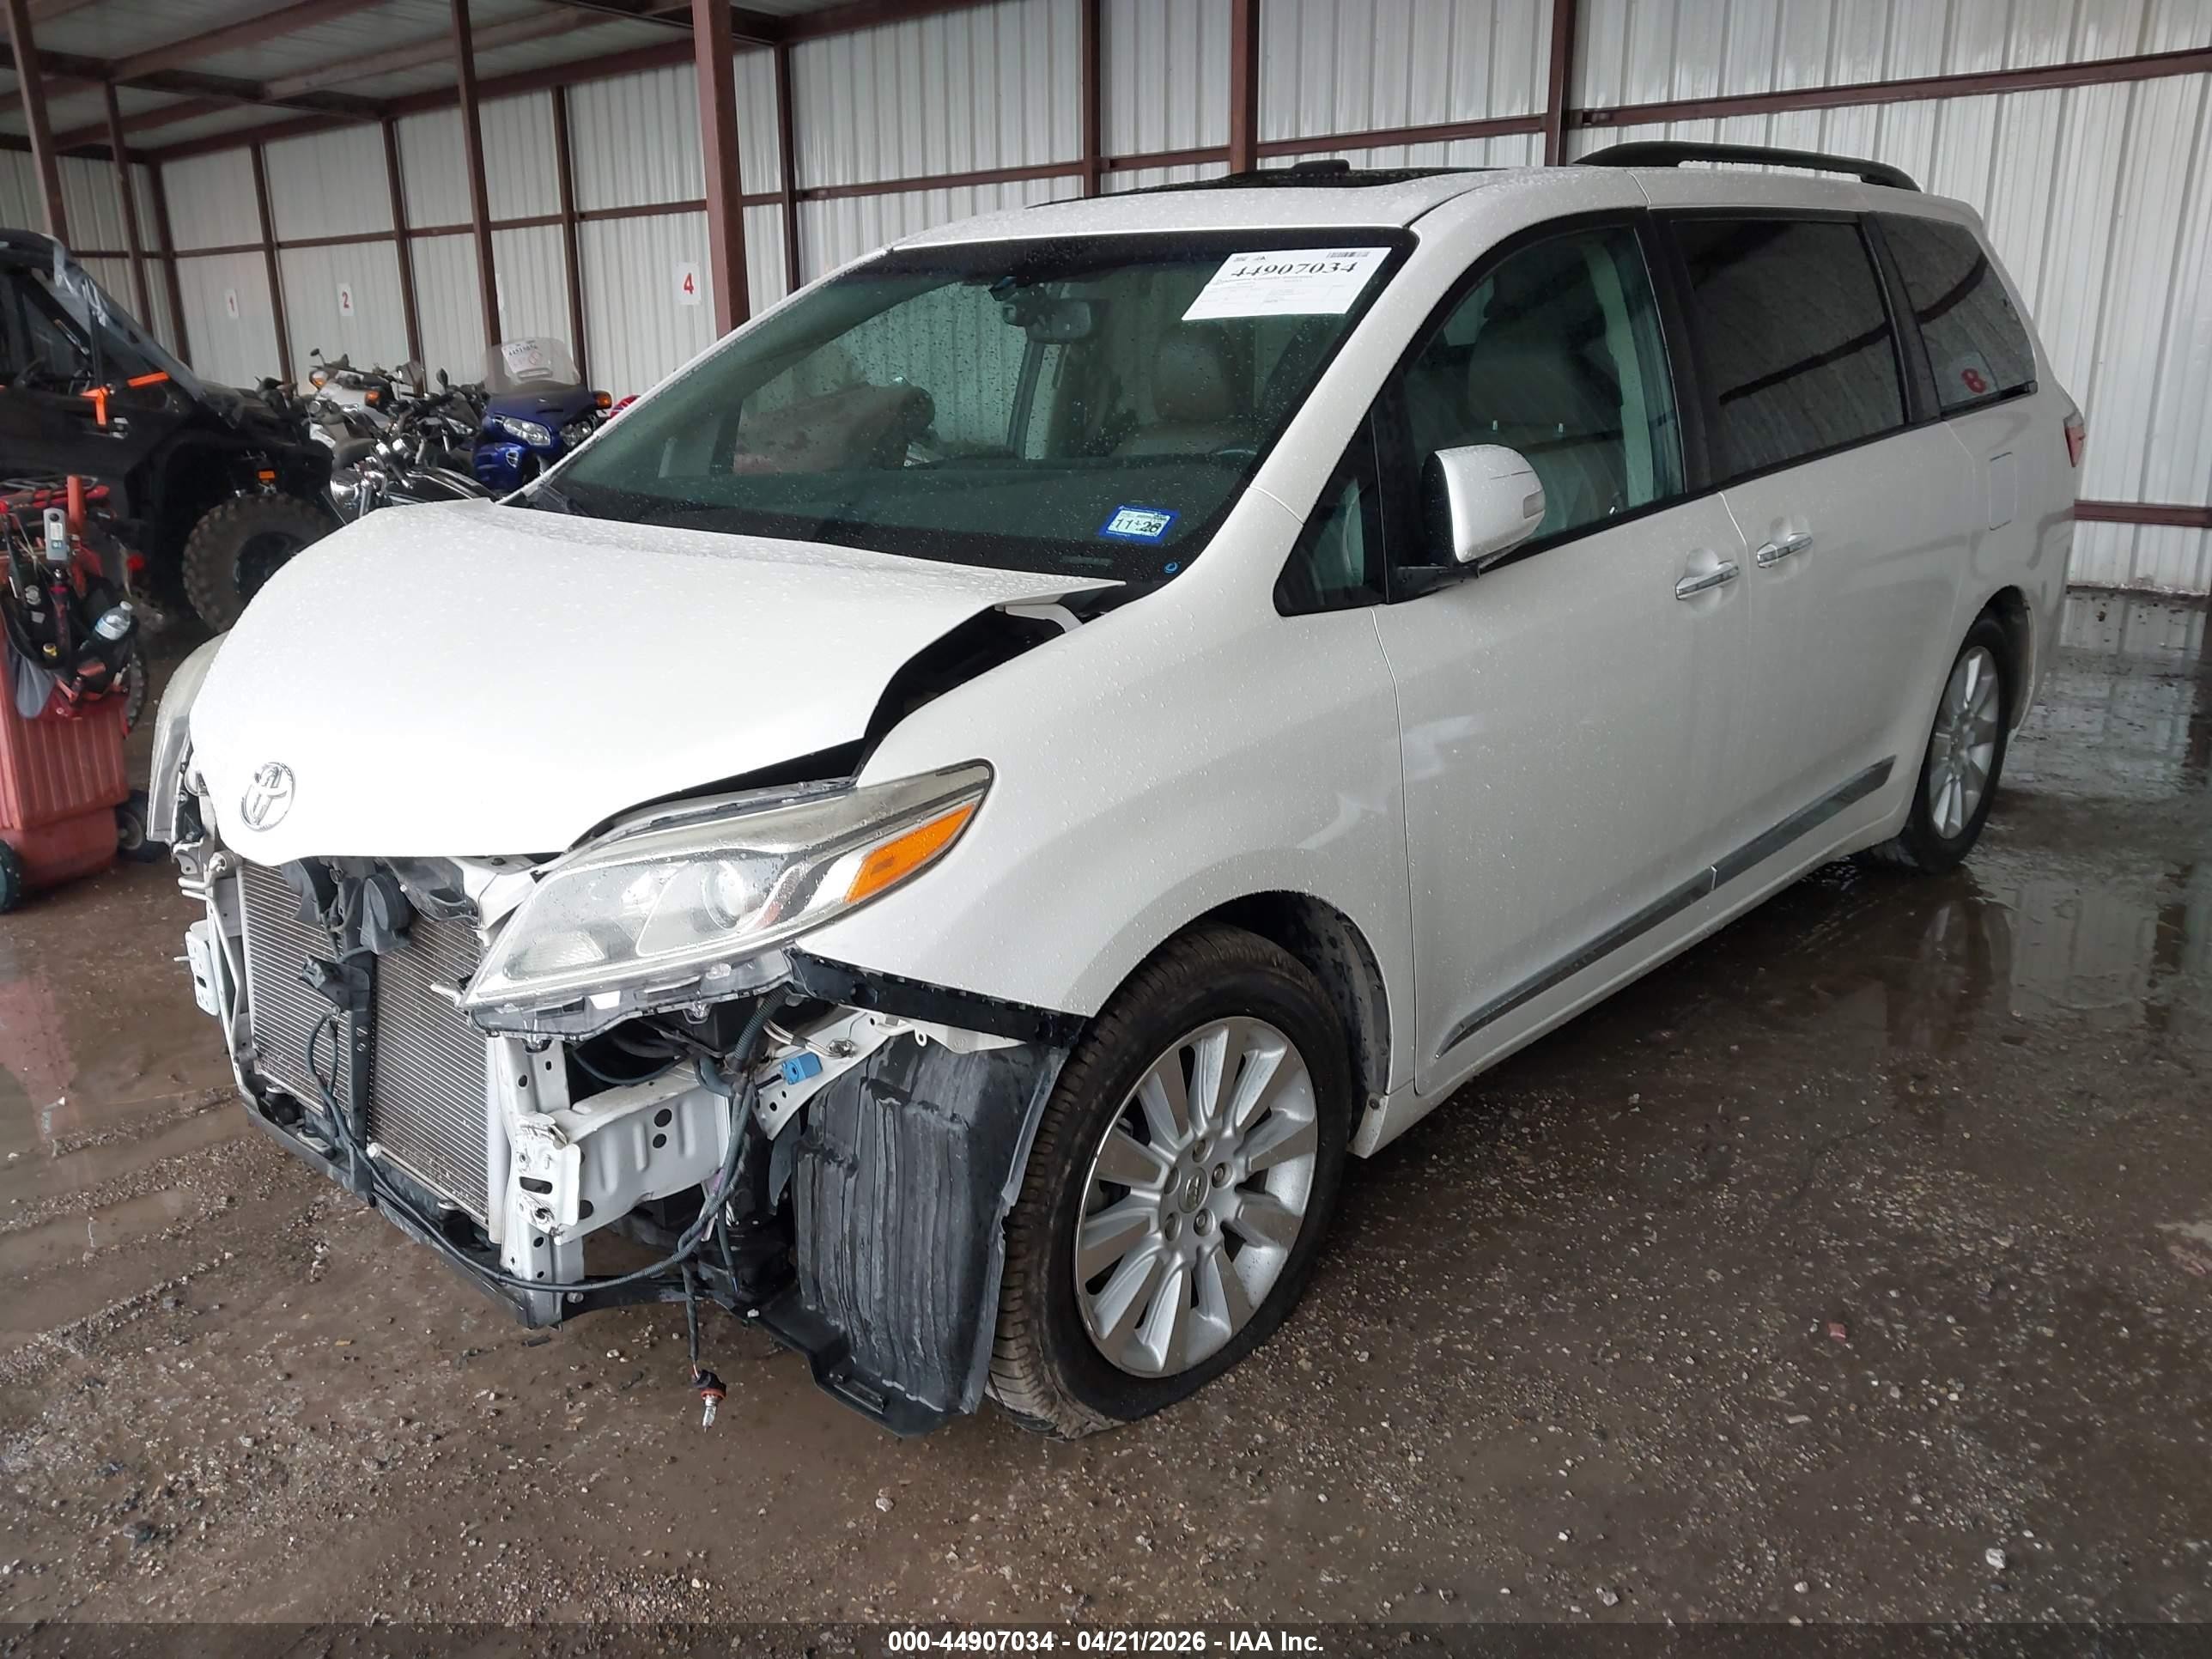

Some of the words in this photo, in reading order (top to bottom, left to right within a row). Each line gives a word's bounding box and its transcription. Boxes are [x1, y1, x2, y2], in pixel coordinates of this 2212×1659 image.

[1231, 261, 1358, 276] 44907034
[684, 272, 695, 295] 4
[228, 295, 235, 313] 1
[342, 290, 350, 309] 2
